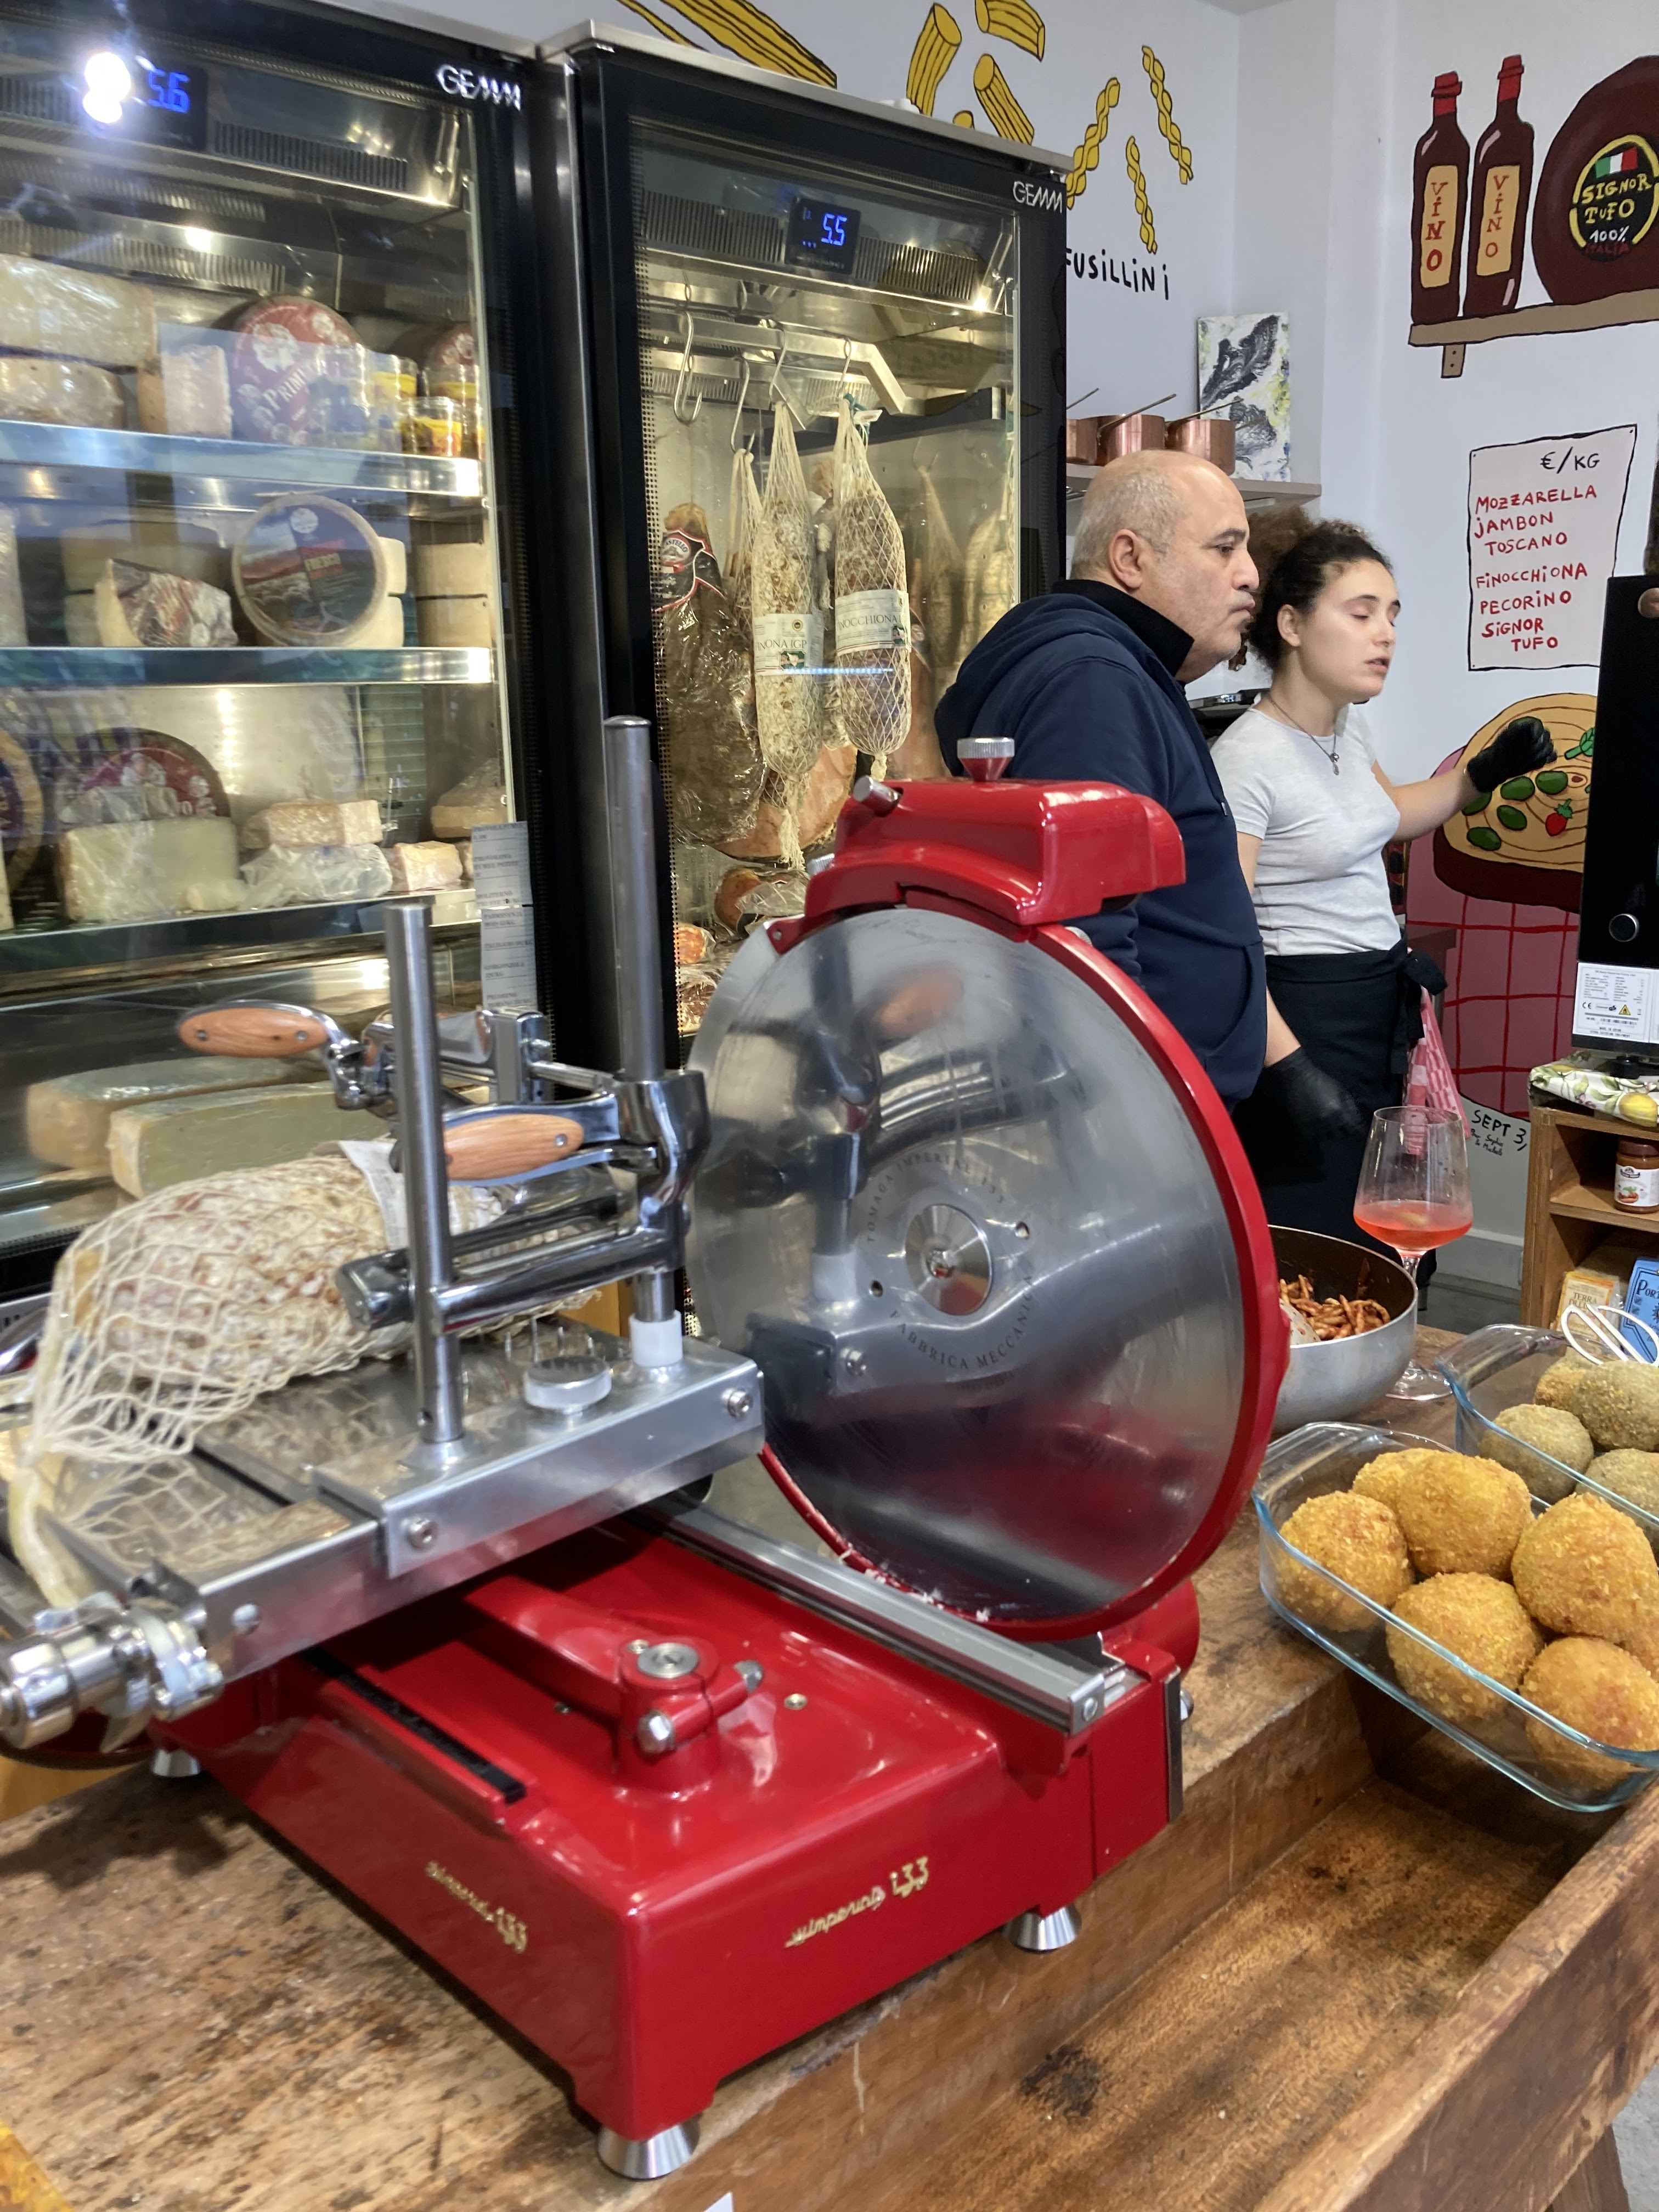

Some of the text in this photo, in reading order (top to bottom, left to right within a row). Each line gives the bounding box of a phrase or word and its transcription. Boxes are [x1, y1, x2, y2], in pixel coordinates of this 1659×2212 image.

[436, 64, 521, 111] GEMM
[1013, 181, 1063, 213] GEMM
[1582, 173, 1652, 204] SIGNOR
[1585, 199, 1635, 224] TUFO
[1589, 225, 1629, 243] 100%
[1475, 484, 1597, 515] MOZZARELLA
[1485, 532, 1568, 556] TOSCANO
[791, 640, 807, 649] IGP
[1511, 636, 1559, 652] TUFO
[1471, 1110, 1511, 1136] SEPT
